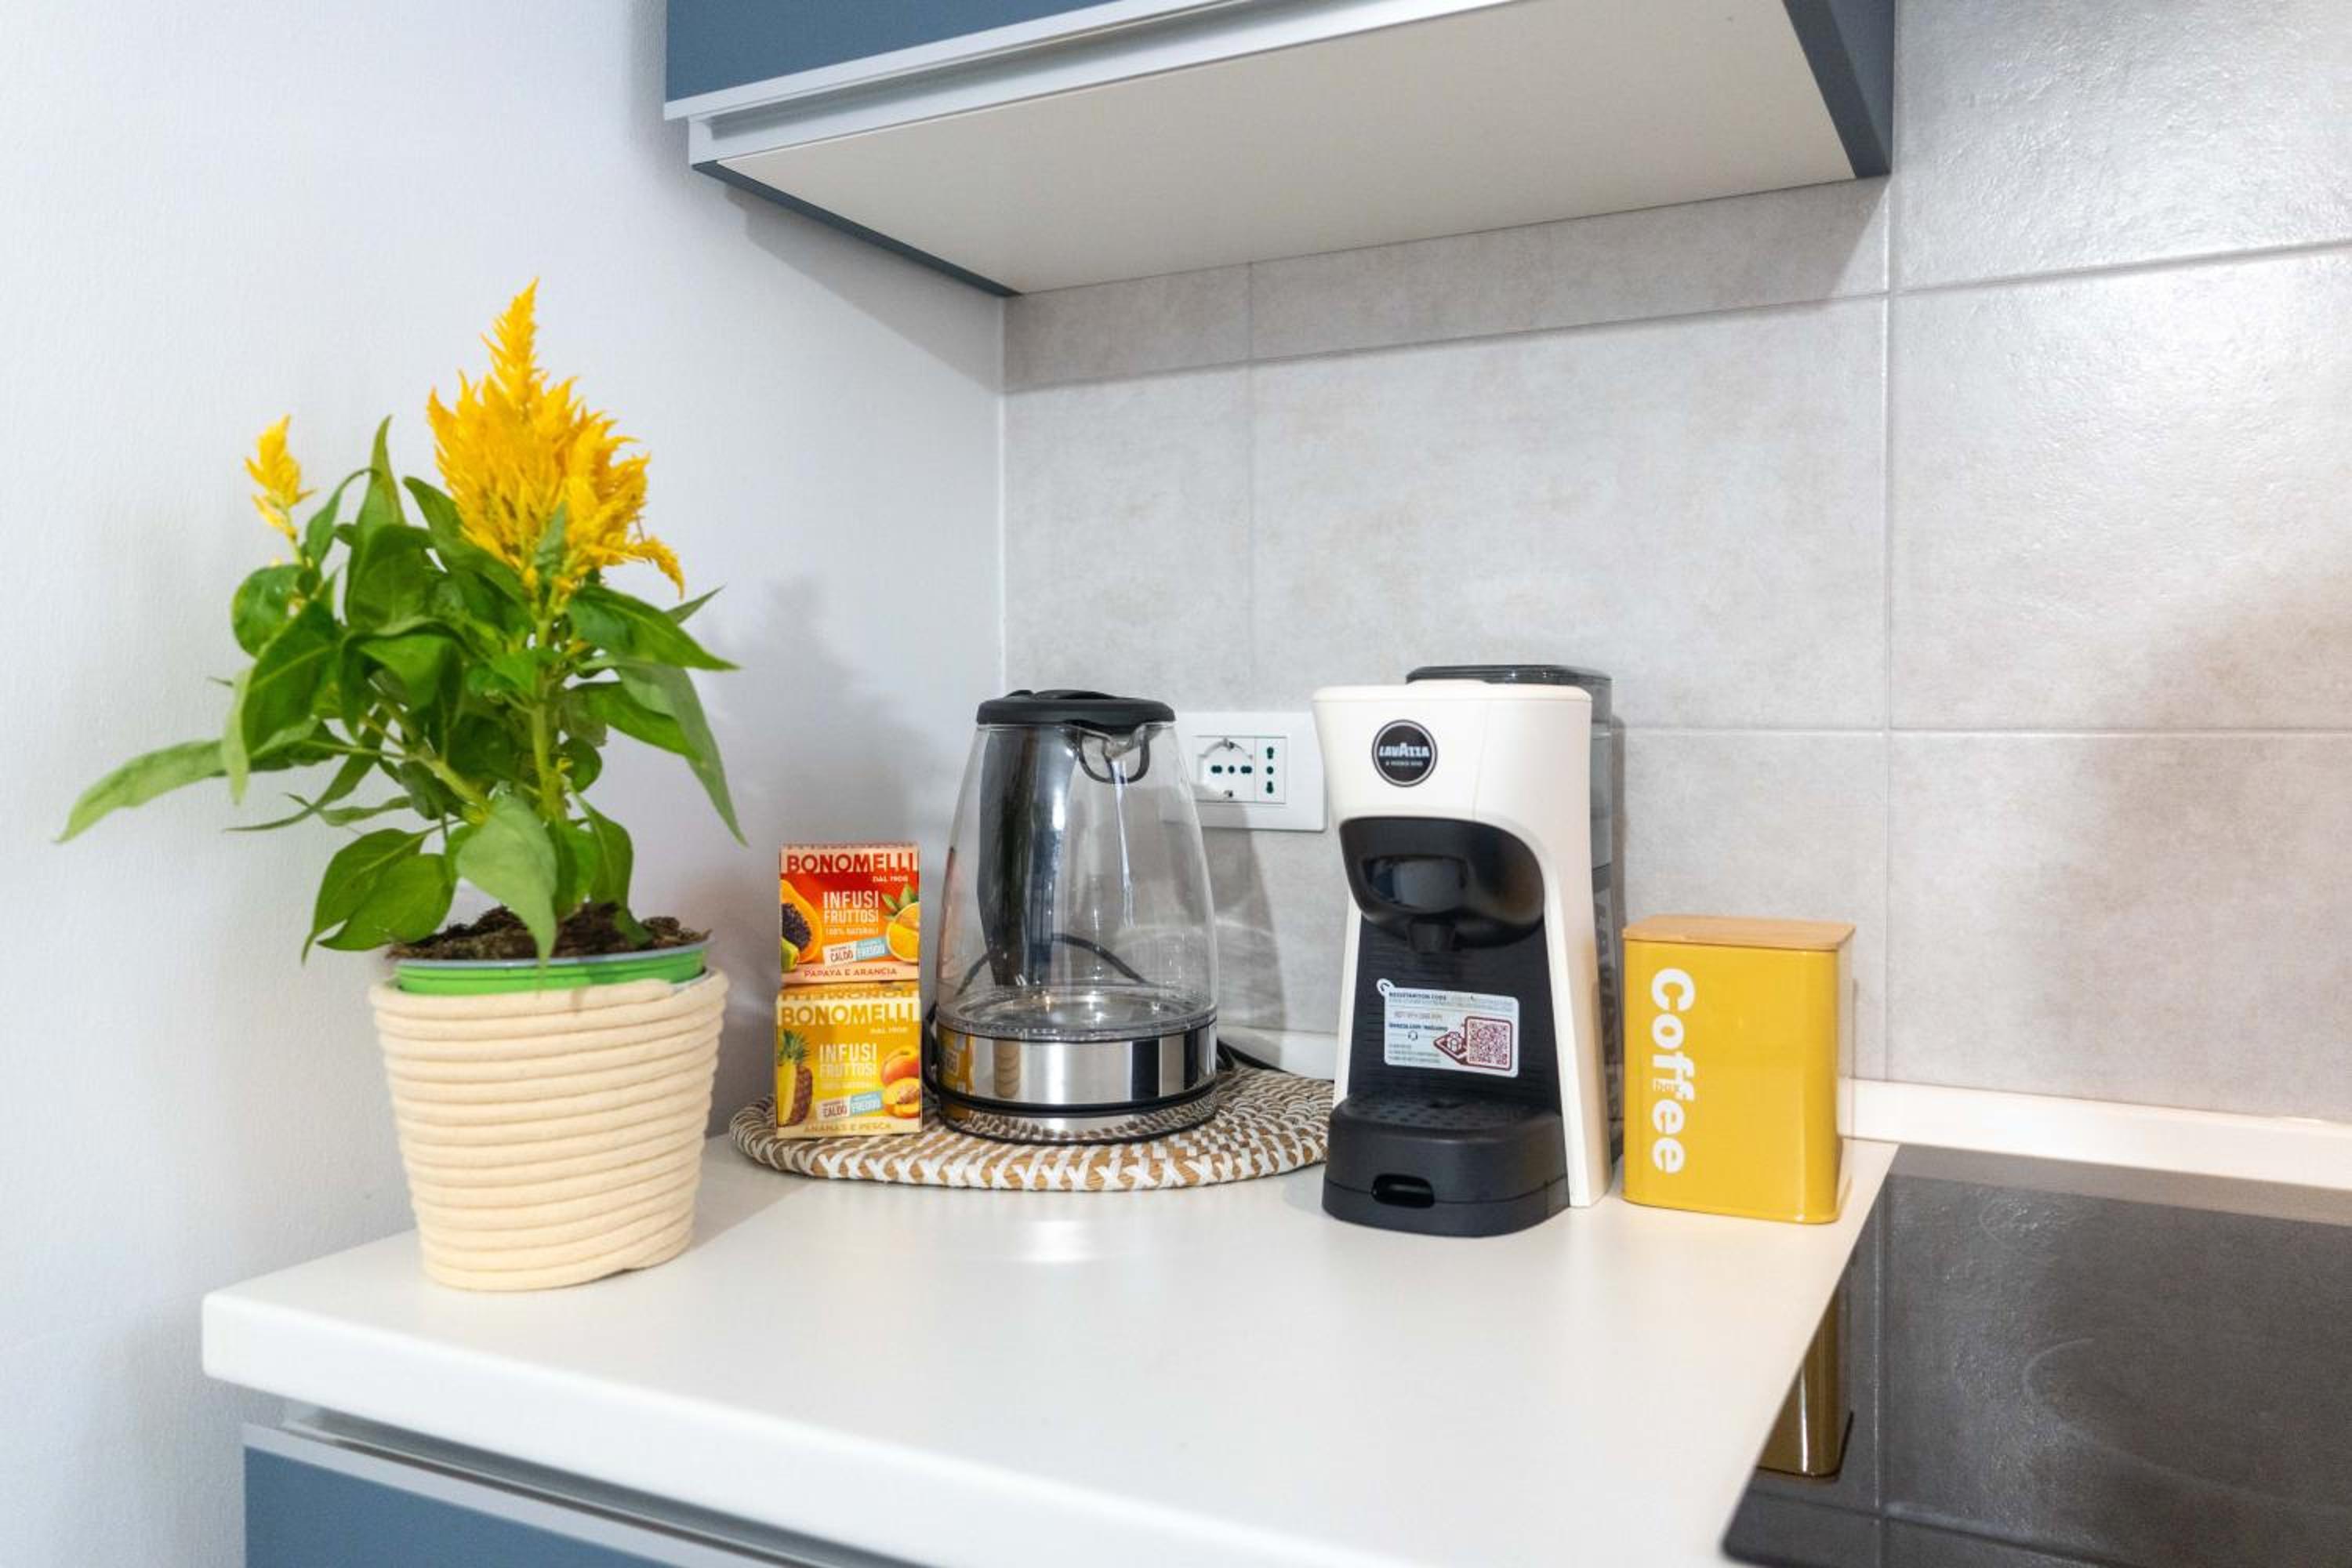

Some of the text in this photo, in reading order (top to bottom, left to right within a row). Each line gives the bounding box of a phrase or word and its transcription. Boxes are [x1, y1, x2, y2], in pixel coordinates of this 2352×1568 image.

[1379, 742, 1430, 757] LAVAZZA
[786, 852, 913, 873] BONOMELLI
[823, 890, 879, 909] INFUSI
[824, 909, 879, 924] FRUTTOSI
[829, 949, 854, 963] CALDO
[804, 968, 842, 978] PAPAYA
[854, 967, 898, 977] ARANCIA
[781, 1003, 914, 1025] BONOMELLI
[819, 1043, 878, 1063] INFUSI
[820, 1062, 878, 1079] FRUTTOSI
[1651, 967, 1695, 1174] Coffee
